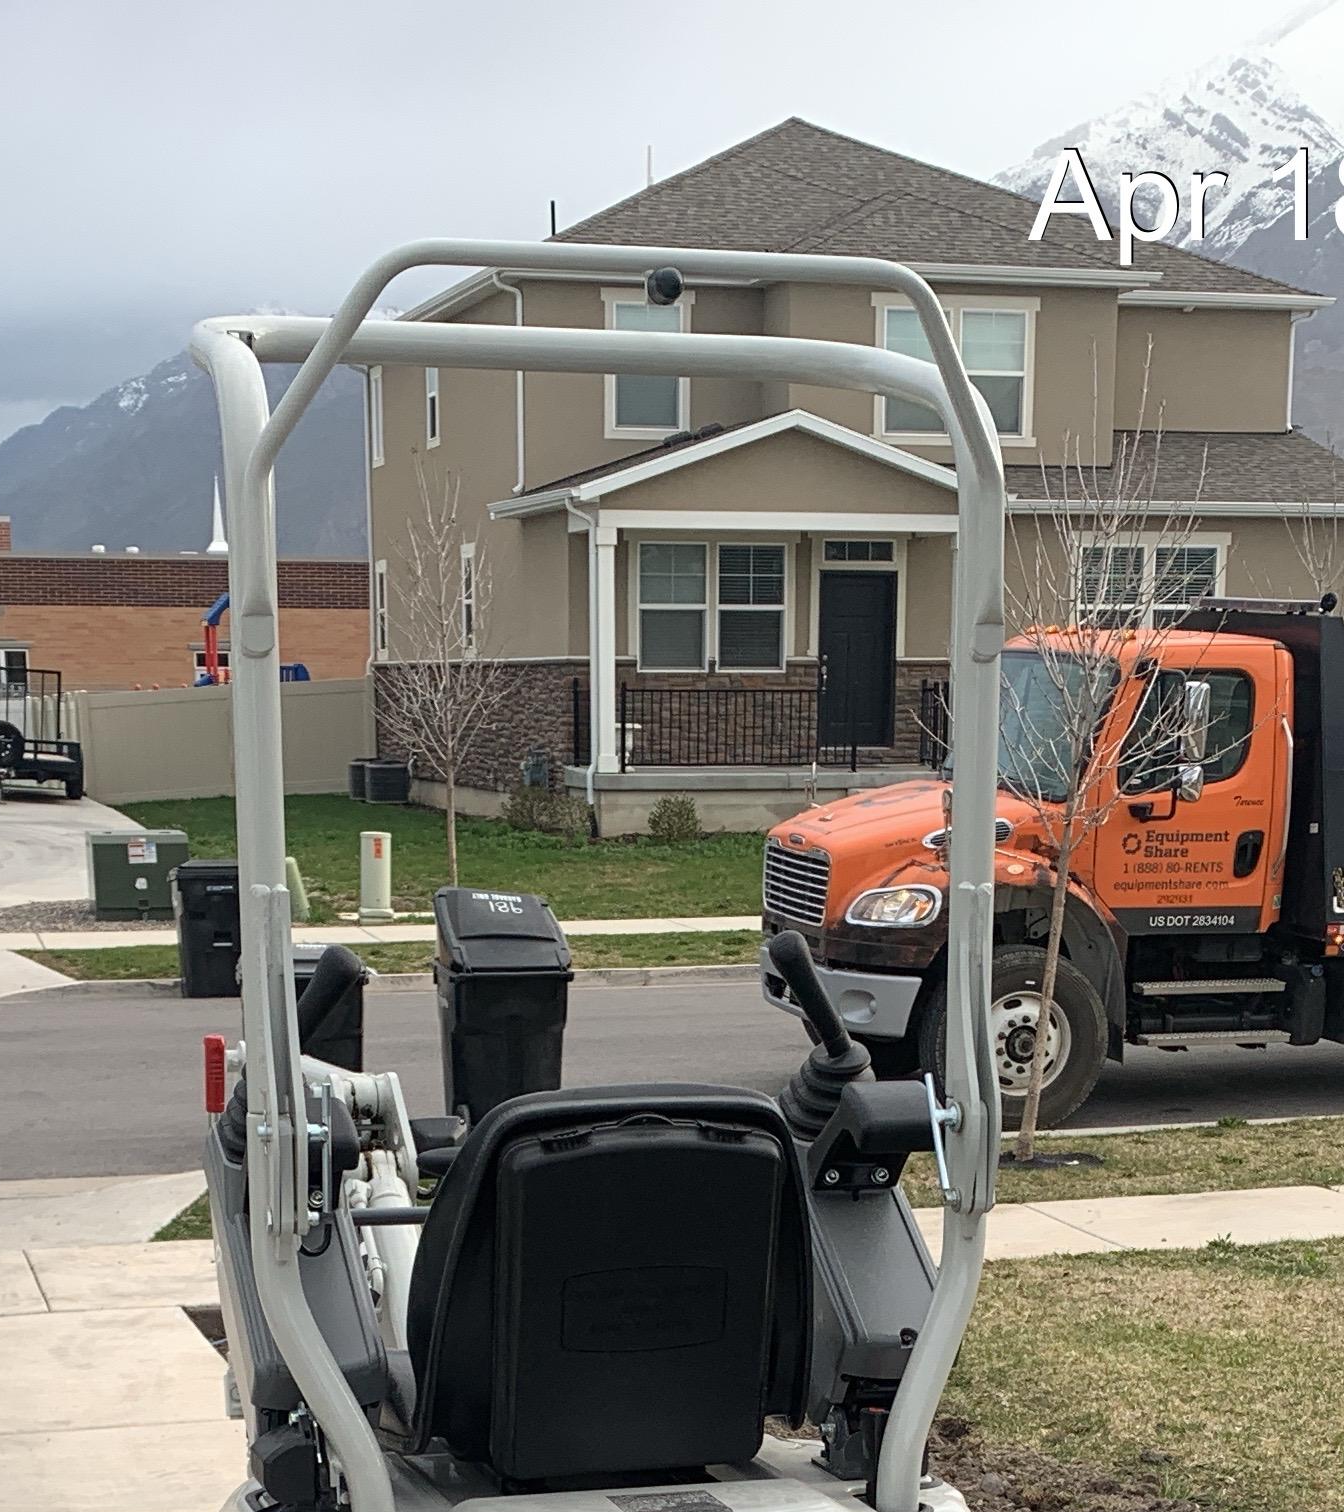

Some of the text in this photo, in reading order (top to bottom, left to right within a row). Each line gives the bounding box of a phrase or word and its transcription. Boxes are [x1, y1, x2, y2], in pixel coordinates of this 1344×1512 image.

[1145, 830, 1230, 845] Equipment
[1144, 846, 1188, 858] Share
[1123, 862, 1224, 874] 1 (888) 80-RENTS
[1113, 879, 1229, 892] equipmentshare.com
[1149, 915, 1235, 926] US DOT 2834104
